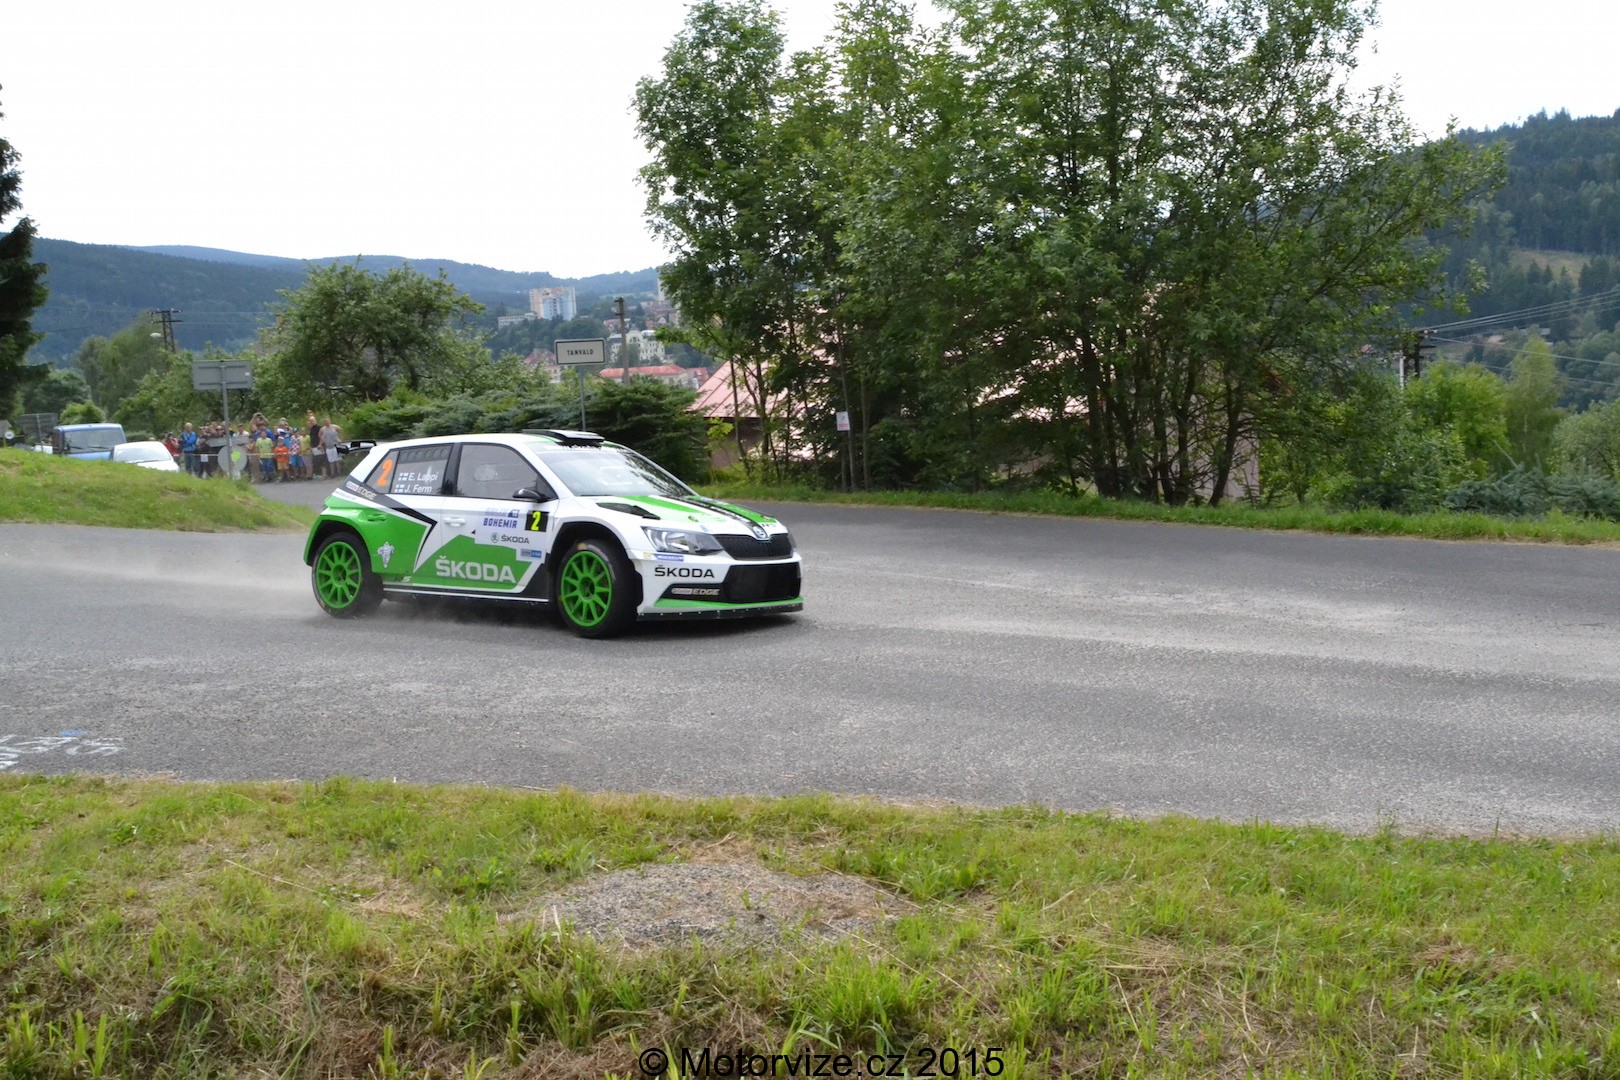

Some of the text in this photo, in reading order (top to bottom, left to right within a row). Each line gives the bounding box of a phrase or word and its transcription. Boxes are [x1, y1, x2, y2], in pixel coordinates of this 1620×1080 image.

[377, 459, 393, 486] 2
[357, 486, 377, 500] EDGE
[531, 511, 541, 531] 2
[501, 534, 530, 544] ŠKODA
[435, 555, 516, 583] ŠKODA
[654, 565, 715, 578] ŠKODA
